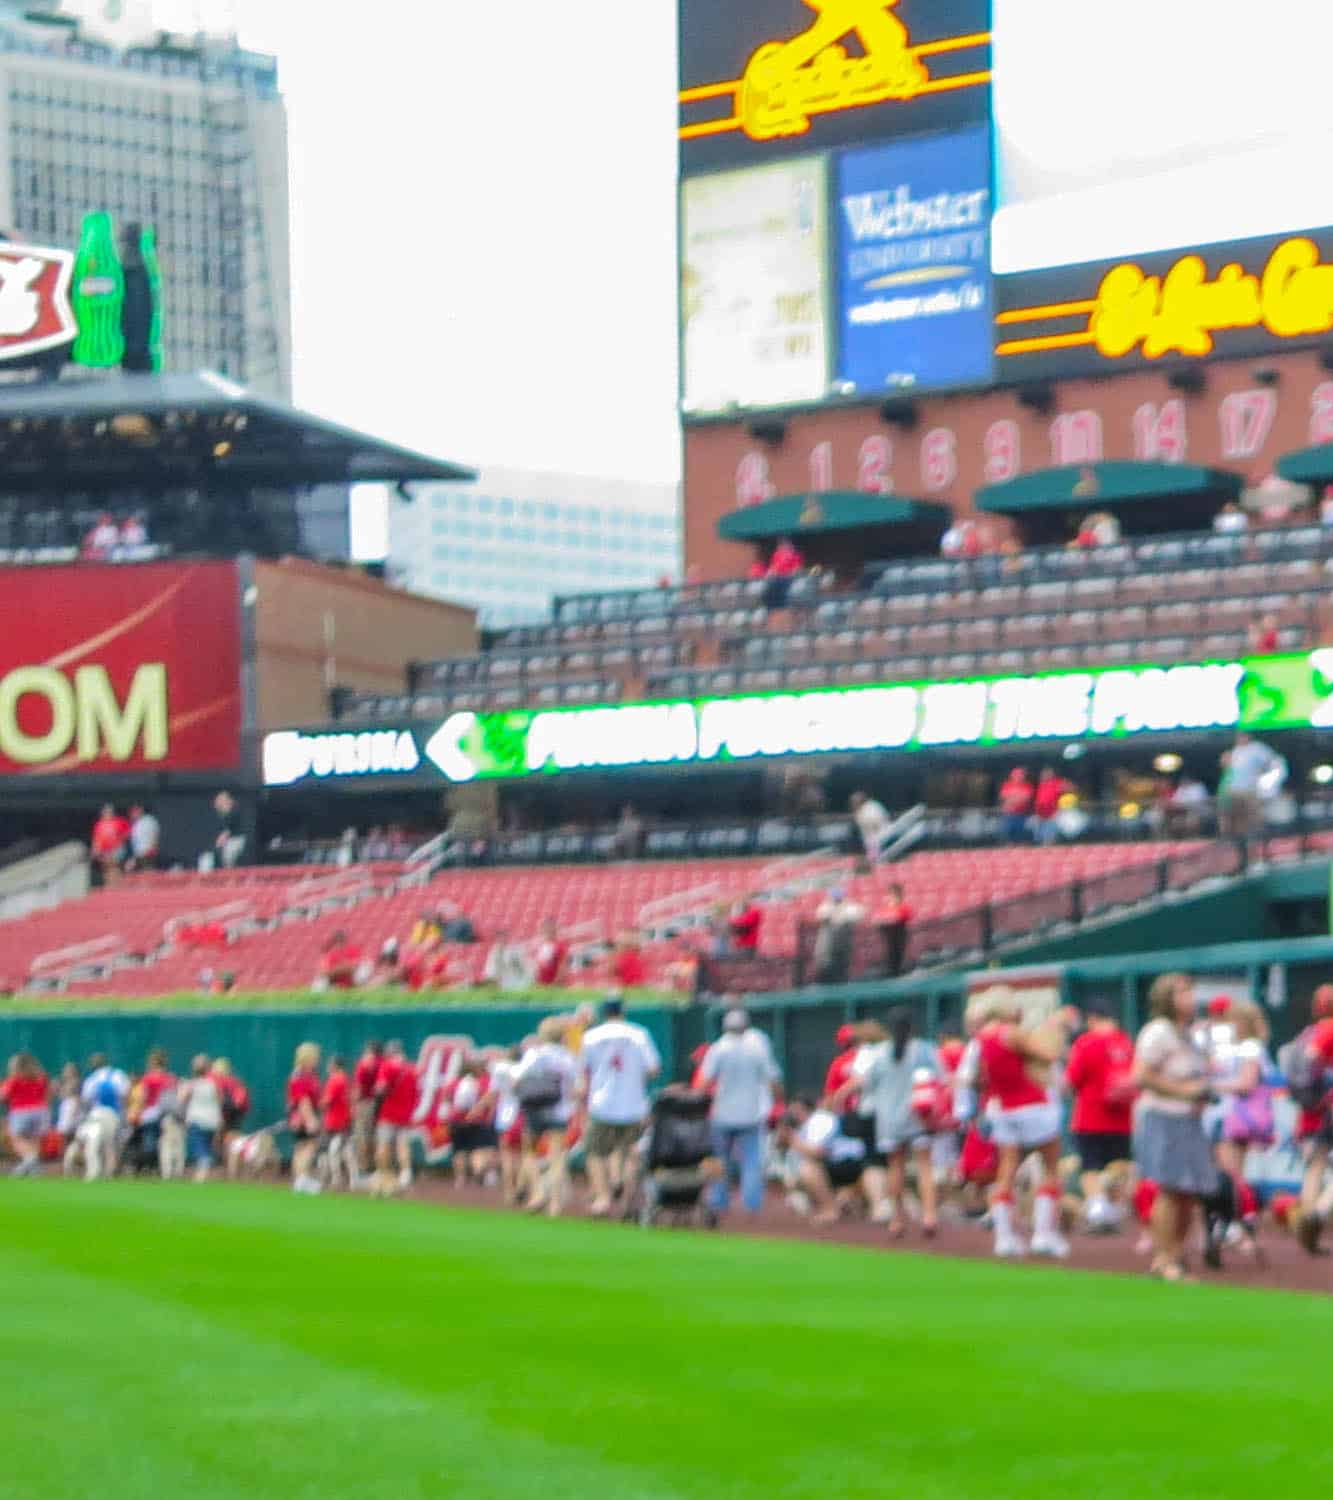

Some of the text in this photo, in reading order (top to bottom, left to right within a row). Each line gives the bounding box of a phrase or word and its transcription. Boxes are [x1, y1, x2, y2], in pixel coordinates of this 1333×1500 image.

[841, 184, 989, 241] Webster
[858, 434, 894, 495] 2
[1219, 388, 1276, 459] 17
